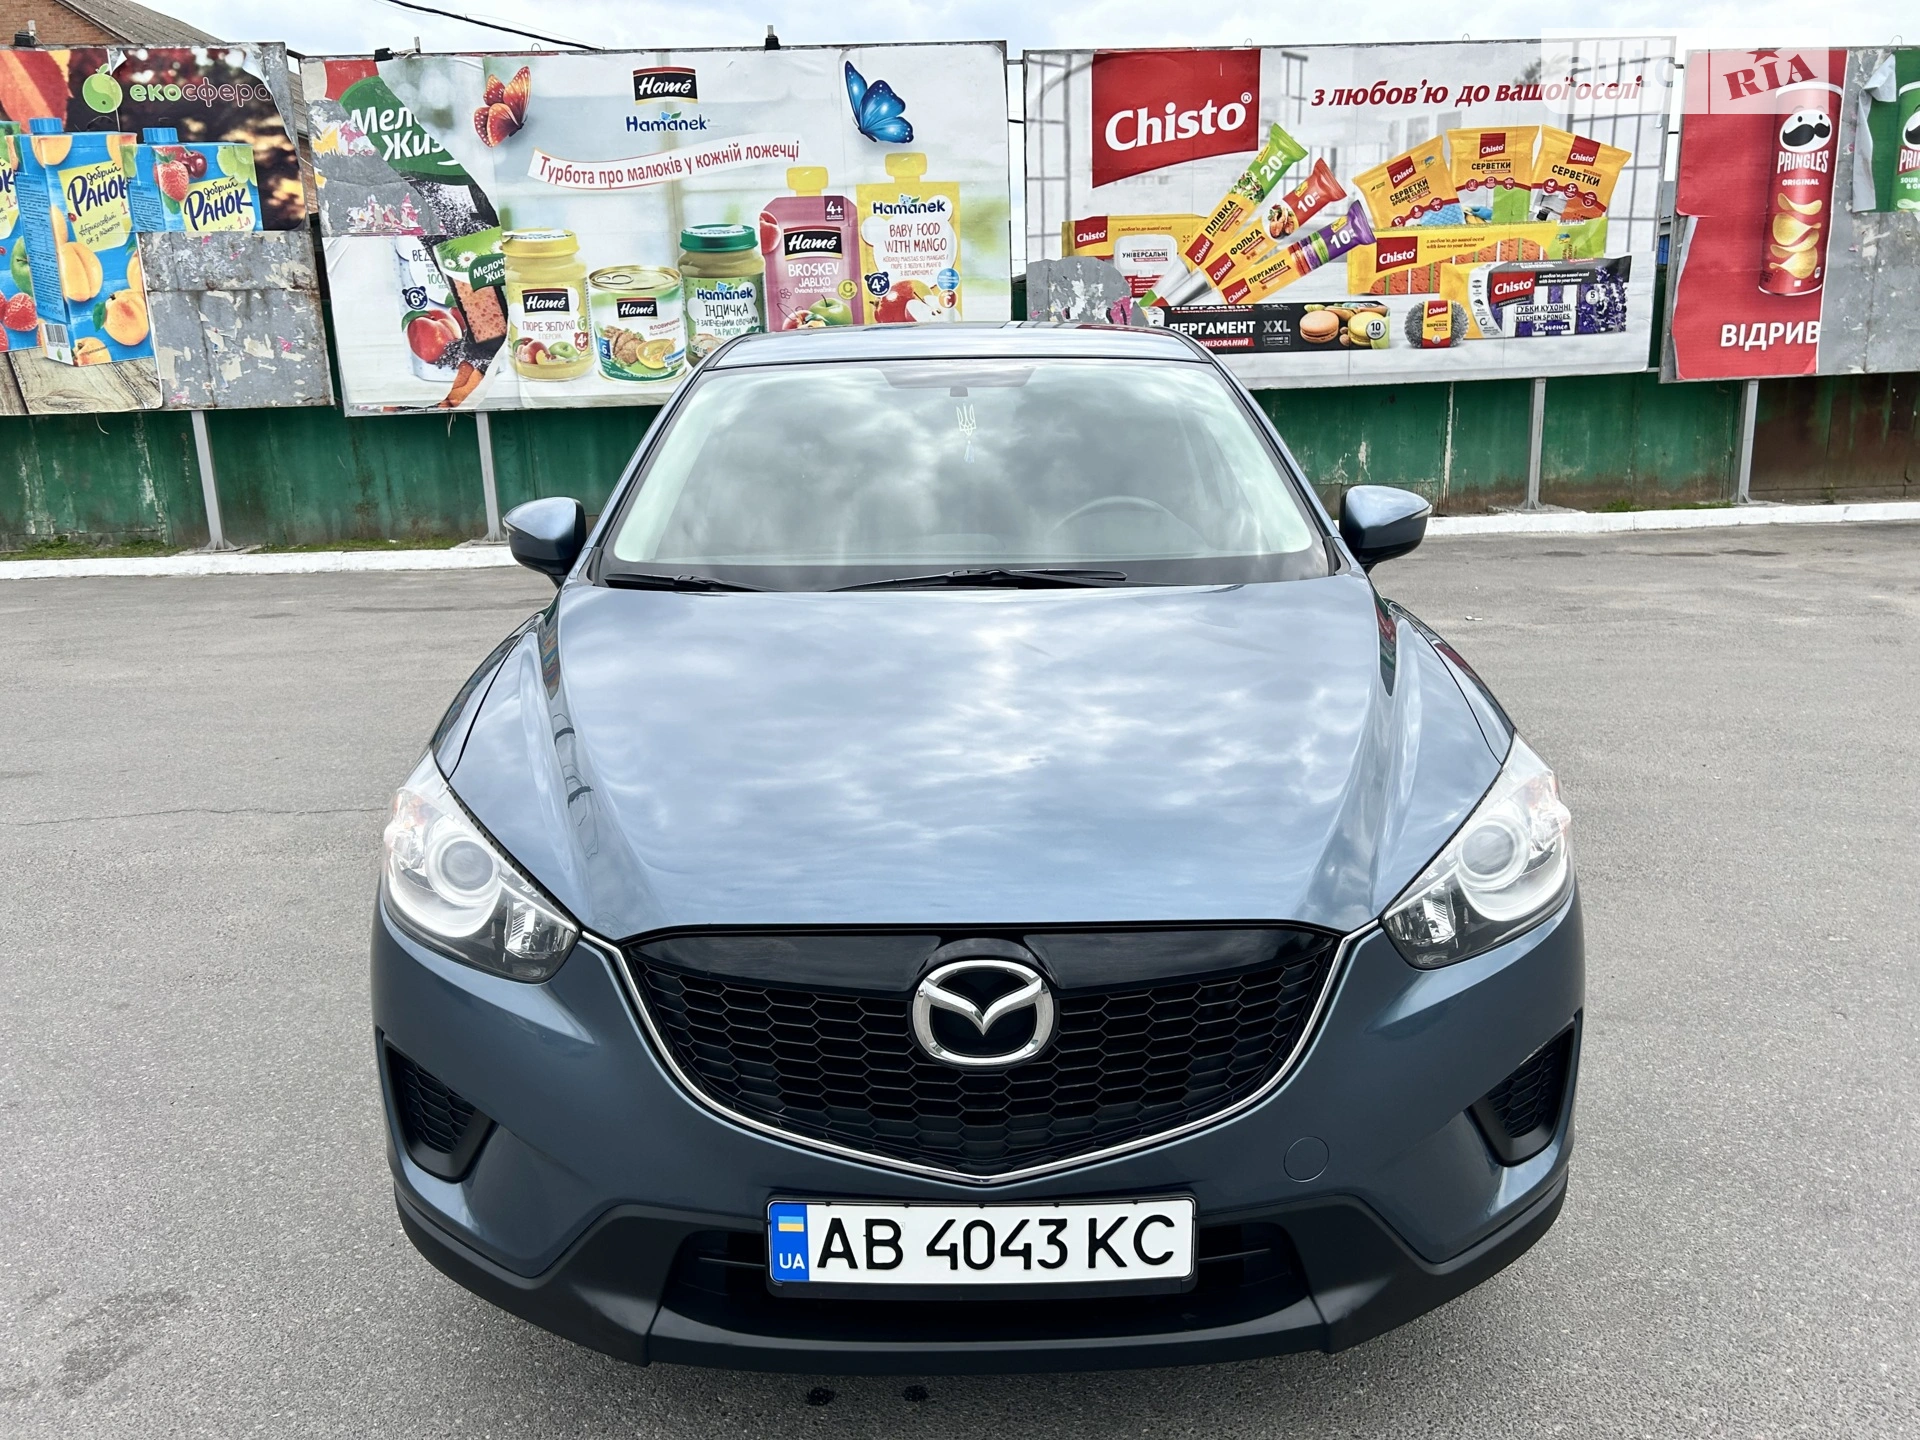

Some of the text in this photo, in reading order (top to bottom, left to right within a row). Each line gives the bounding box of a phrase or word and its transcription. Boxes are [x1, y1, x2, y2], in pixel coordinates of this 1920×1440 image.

[130, 77, 271, 107] екосфера
[638, 76, 692, 95] Hamé
[1311, 88, 1324, 106] з
[1454, 84, 1490, 107] до
[351, 106, 419, 134] Мел
[538, 140, 800, 188] Турбота про малюків у кожній ложечці
[1471, 162, 1511, 170] СЕРВЕТКИ
[1777, 150, 1829, 174] PRINGLES
[1551, 164, 1601, 187] СЕРВЕТКИ
[203, 176, 238, 200] добрий
[1389, 178, 1429, 202] СЕРВЕТКИ
[826, 200, 843, 215] 4+
[1205, 200, 1237, 235] ПЛІВКА
[889, 222, 940, 238] BABY FOOD
[788, 234, 837, 251] Hamé
[884, 238, 948, 253] WITH MANGO
[1230, 229, 1262, 256] ФОЛЬГА
[1379, 249, 1415, 265] Chisto
[788, 262, 840, 277] BROSKEV
[1248, 259, 1286, 284] ПЕРГАМЕНТ
[798, 276, 831, 288] JABLKO
[871, 278, 886, 292] 4+
[1494, 280, 1533, 295] Chisto
[410, 292, 424, 306] 6+
[526, 296, 566, 310] Hamé
[1590, 291, 1596, 299] 5
[619, 303, 654, 315] Hamé
[705, 303, 749, 319] ІНДИЧКА
[1516, 304, 1571, 312] ГУБКИ КУХОННІ
[544, 319, 576, 332] ЯБЛУКО
[1263, 320, 1291, 333] XXL
[1370, 322, 1381, 332] 10
[1720, 321, 1820, 351] ВІДРИВ
[816, 1214, 1175, 1271] AB 4043 KC
[779, 1253, 806, 1270] UA
